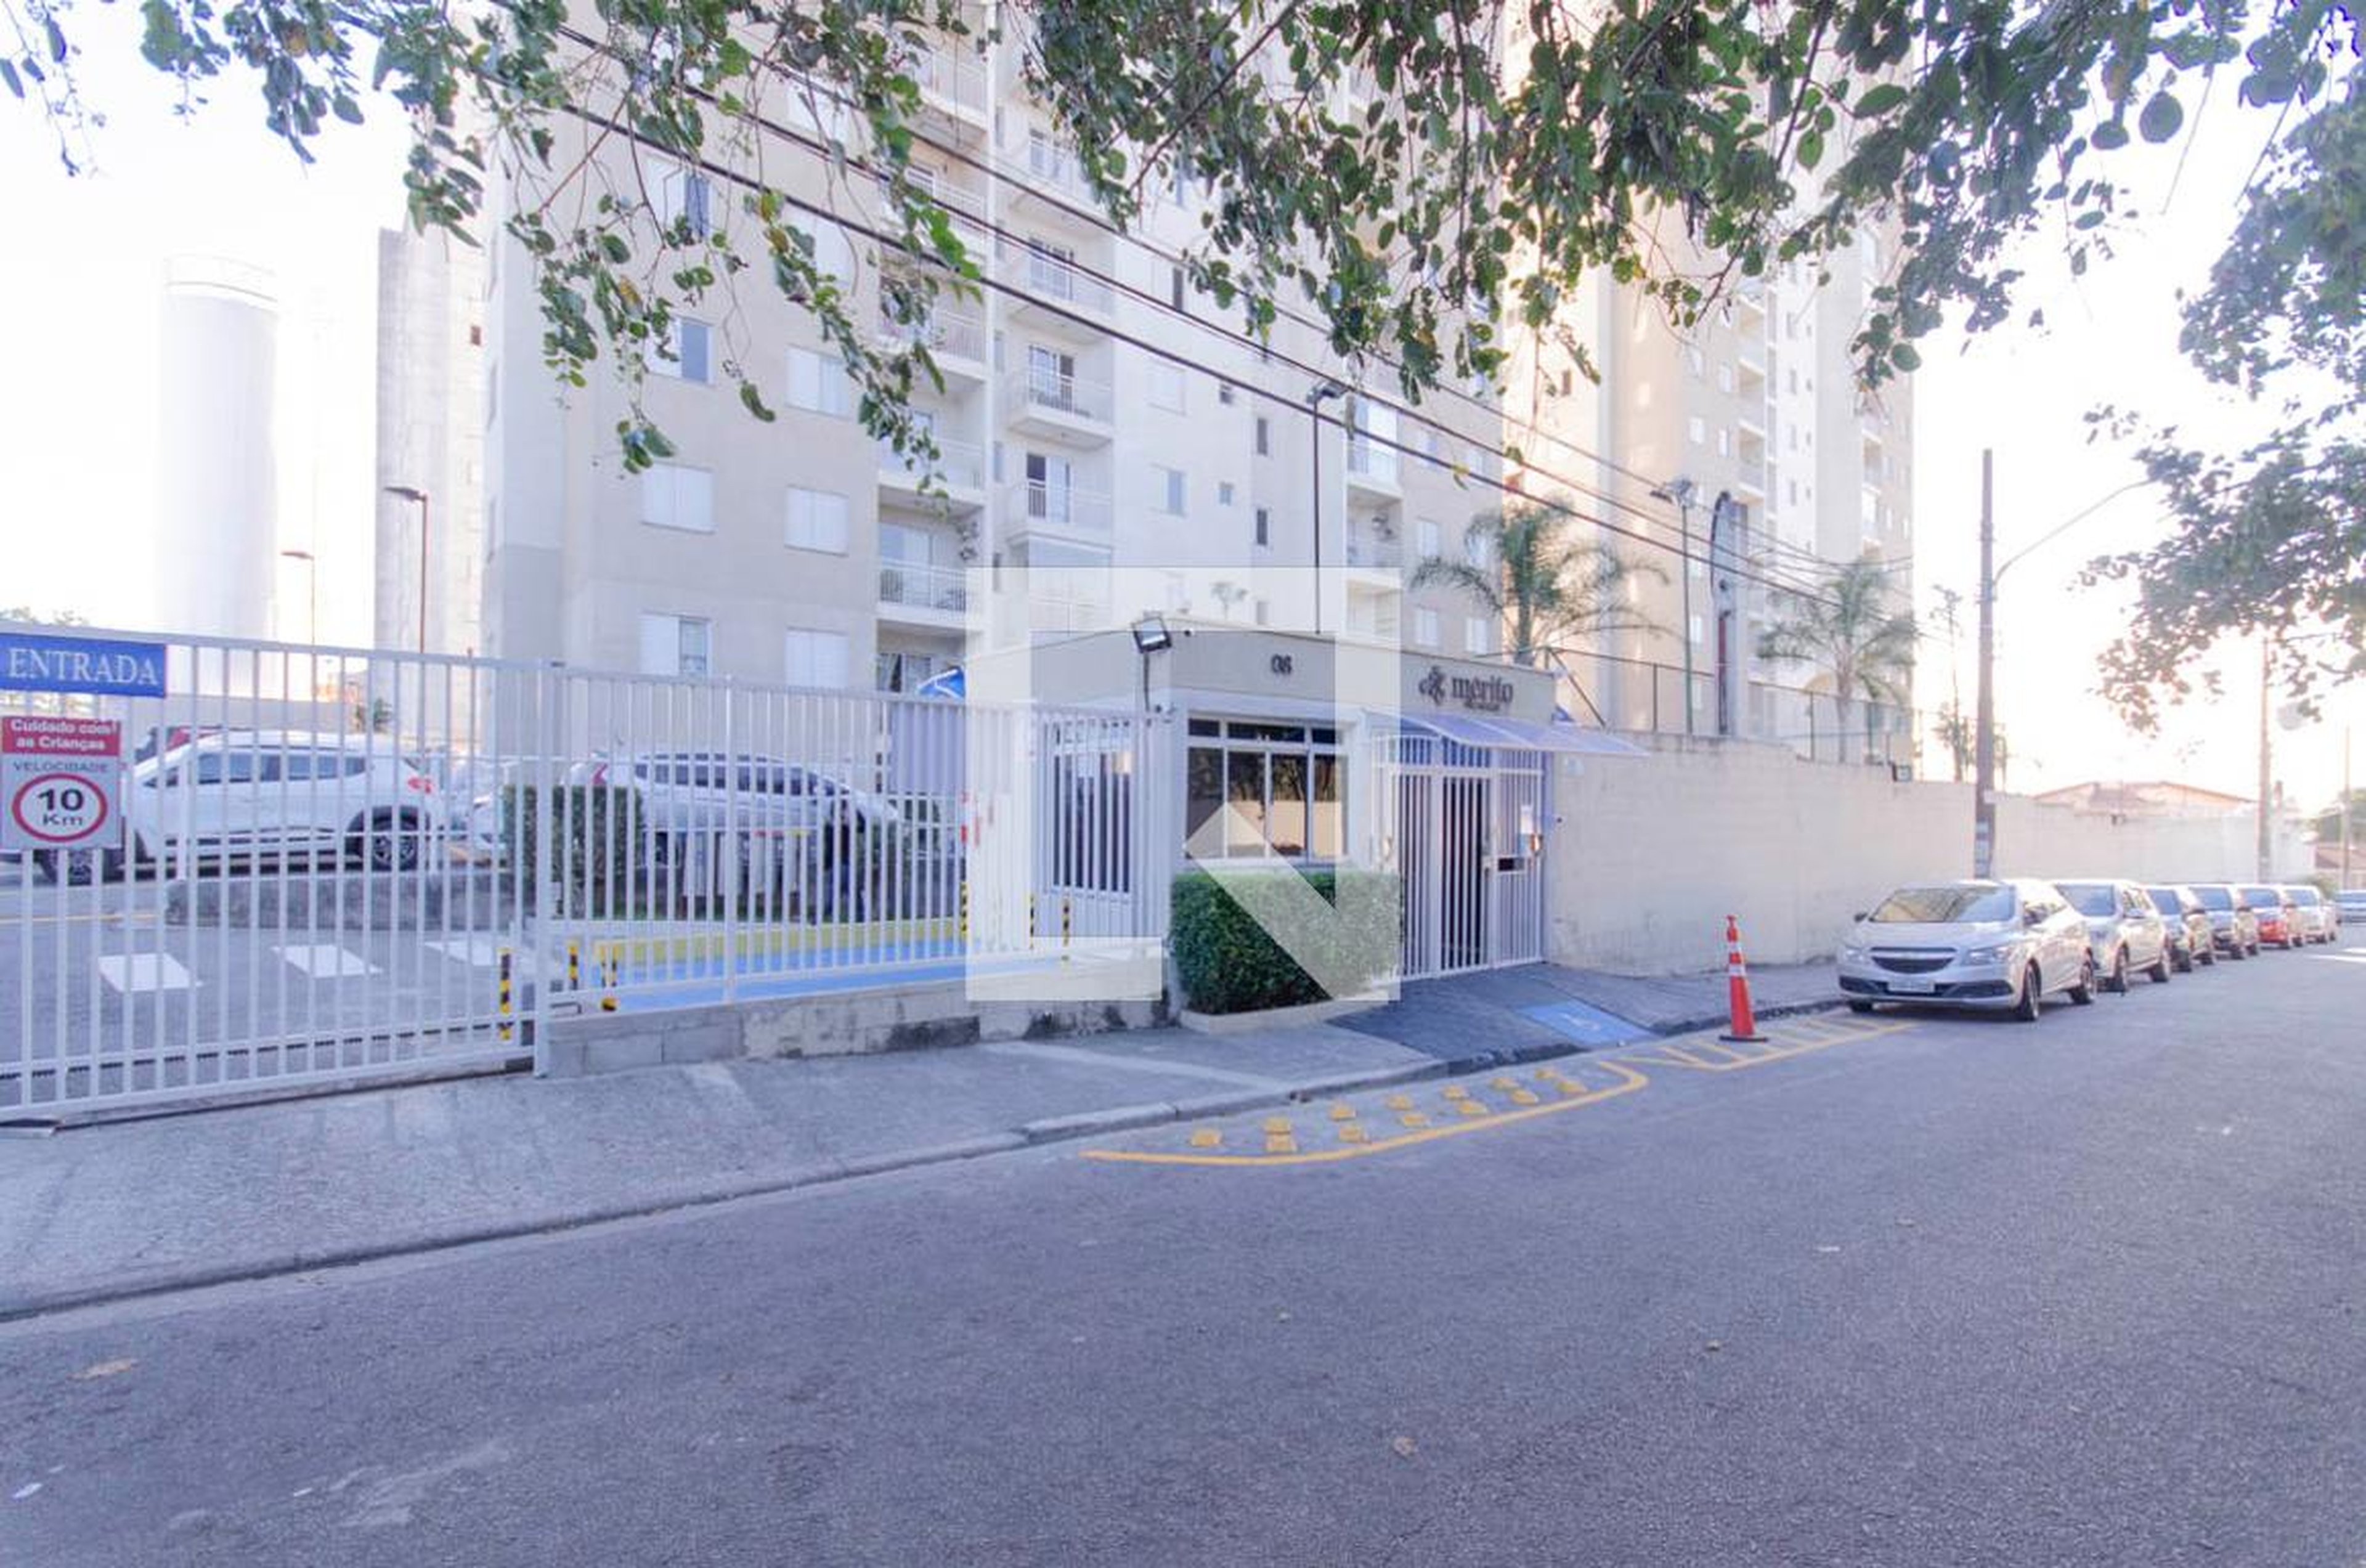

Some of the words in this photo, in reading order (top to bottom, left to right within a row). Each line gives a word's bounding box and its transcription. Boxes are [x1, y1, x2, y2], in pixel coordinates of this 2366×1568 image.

[9, 649, 158, 685] ENTRADA
[10, 719, 75, 733] Cuidado
[79, 724, 111, 734] com
[16, 737, 34, 748] as
[38, 736, 105, 750] Crianças
[13, 761, 108, 773] VELOCIDADE
[38, 789, 84, 811] 10
[43, 813, 83, 826] Km
